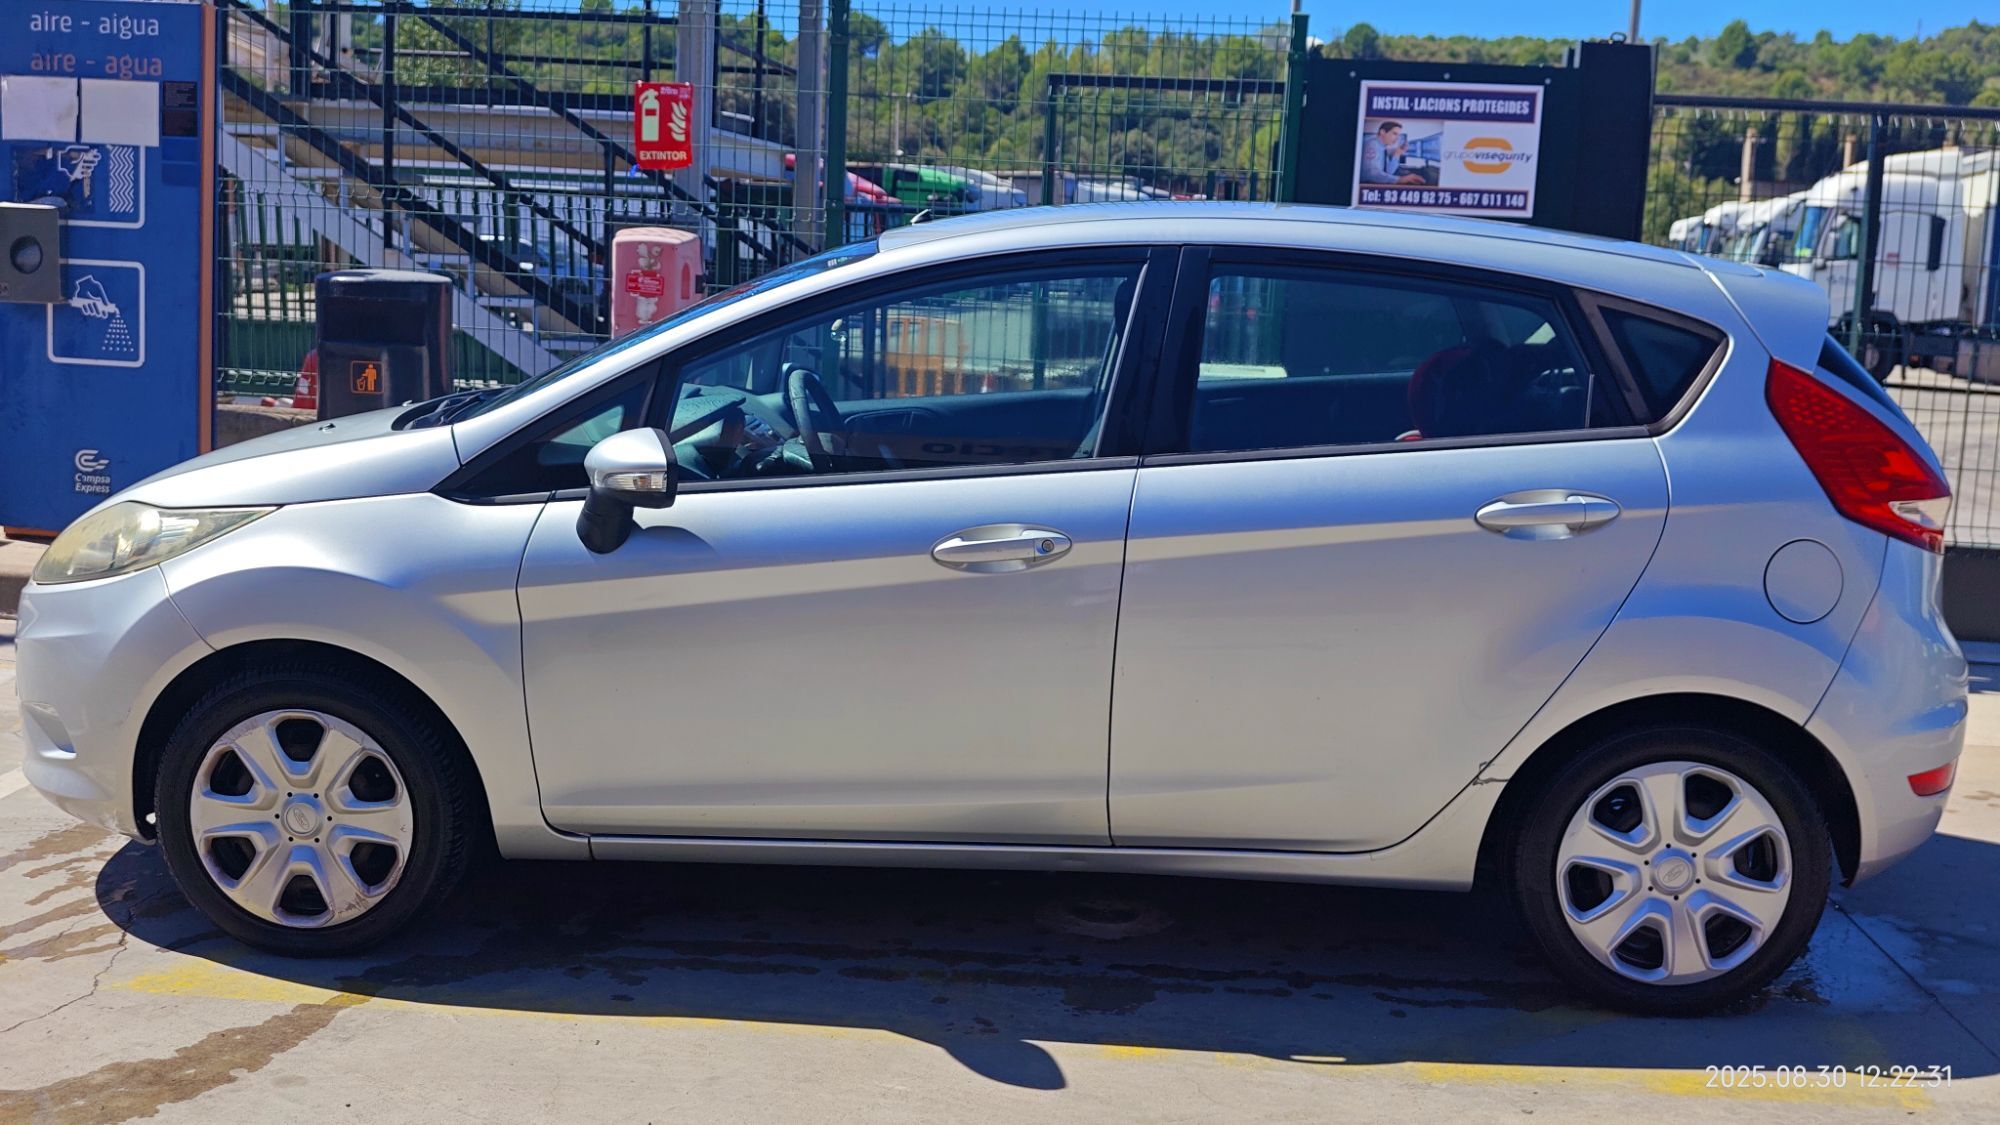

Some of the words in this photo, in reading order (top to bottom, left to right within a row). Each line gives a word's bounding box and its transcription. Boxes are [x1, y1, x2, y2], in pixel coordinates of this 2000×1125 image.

[30, 11, 72, 33] aire
[99, 13, 160, 40] aigua
[31, 51, 76, 72] aire
[105, 54, 163, 80] agua
[1462, 98, 1531, 115] PROTEGIDES
[640, 150, 687, 160] EXTINTOR
[1362, 189, 1381, 202] Tel:
[1384, 190, 1398, 202] 93
[1400, 190, 1420, 203] 449
[1421, 191, 1436, 204] 92
[1437, 191, 1451, 205] 75
[1459, 192, 1480, 206] 667
[1481, 193, 1501, 207] 611
[1505, 194, 1525, 207] 140
[75, 483, 110, 494] Express
